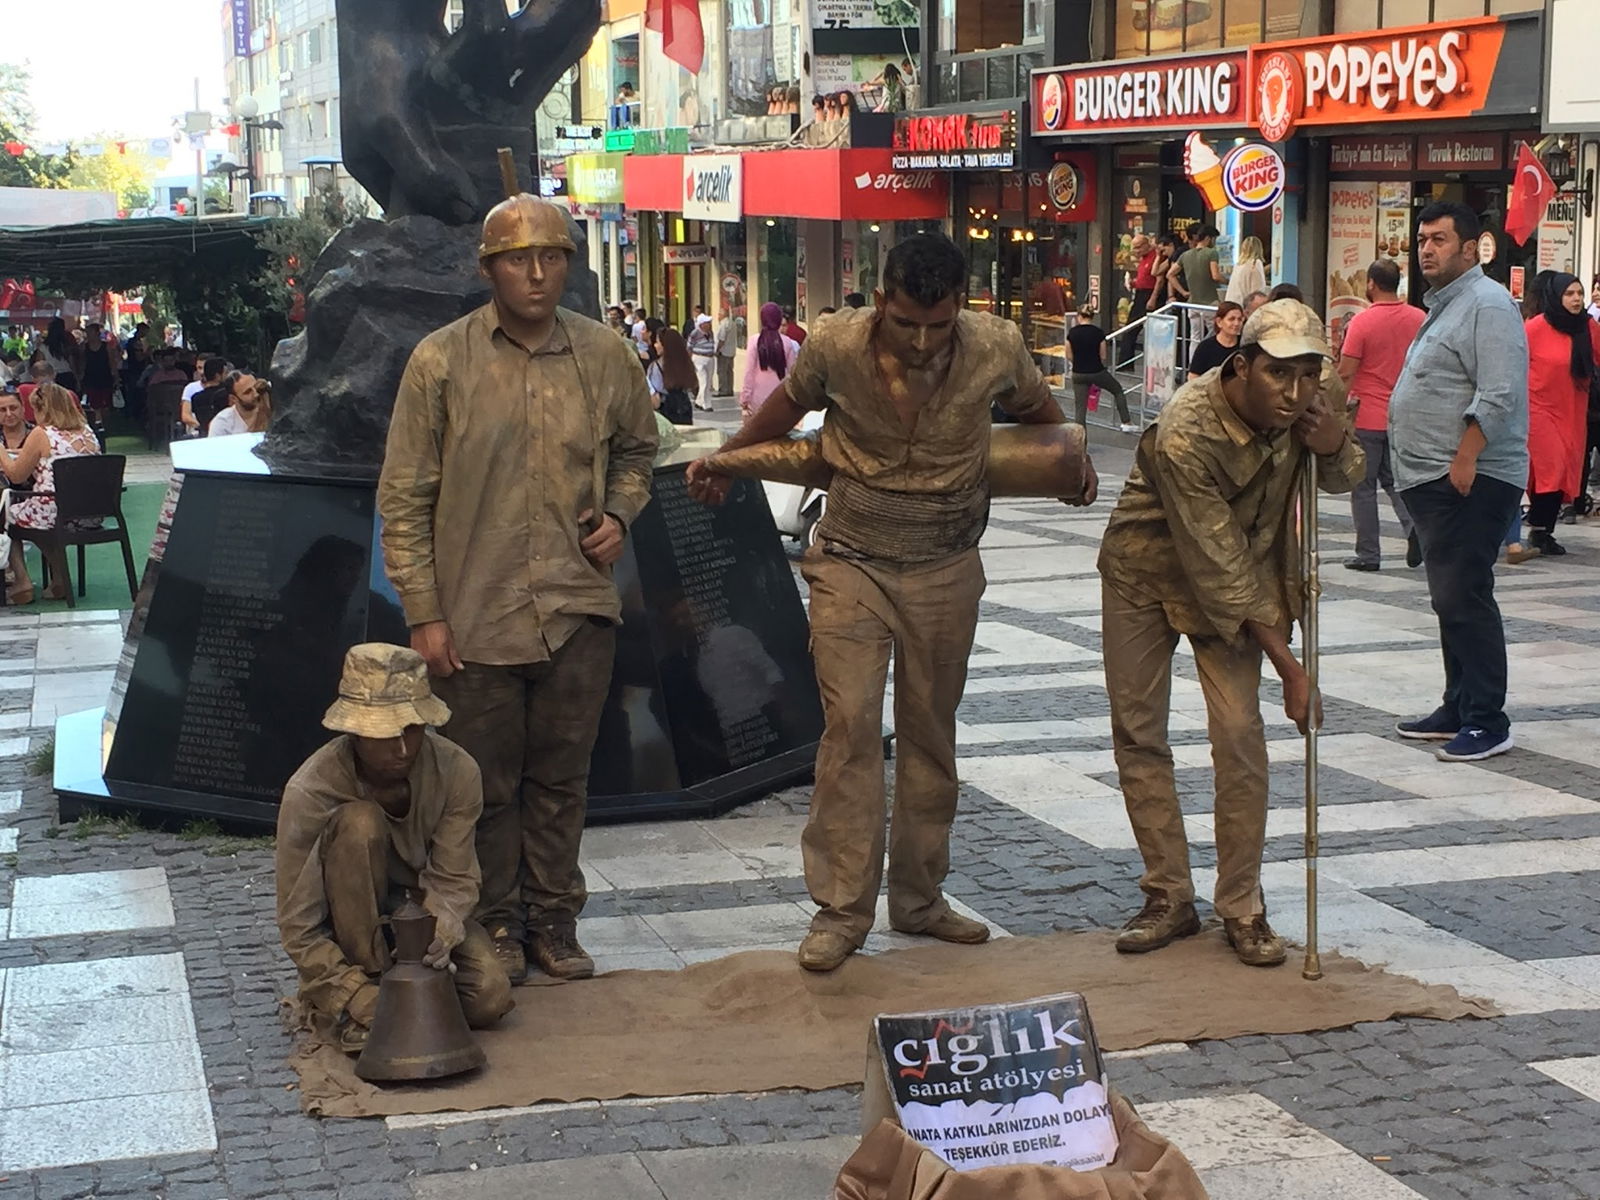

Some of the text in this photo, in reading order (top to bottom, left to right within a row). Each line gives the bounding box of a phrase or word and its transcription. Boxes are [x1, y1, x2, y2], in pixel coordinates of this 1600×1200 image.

[1074, 61, 1232, 121] BURGER KING
[909, 114, 968, 151] KONAK
[1232, 155, 1277, 180] BURGER
[1331, 144, 1371, 167] Türkiye'nin
[1373, 144, 1382, 163] En
[1427, 143, 1452, 163] Tavuk
[1454, 142, 1494, 163] Restoran
[696, 165, 733, 212] arçelik
[873, 171, 935, 193] arçelik
[1055, 179, 1074, 197] KING
[1234, 166, 1279, 196] KING
[908, 1058, 1087, 1097] sanat atölyesi
[943, 1114, 1060, 1141] KATKILARINIZDAN
[943, 1134, 1066, 1162] TEŞEKKÜR EDERİZ.
